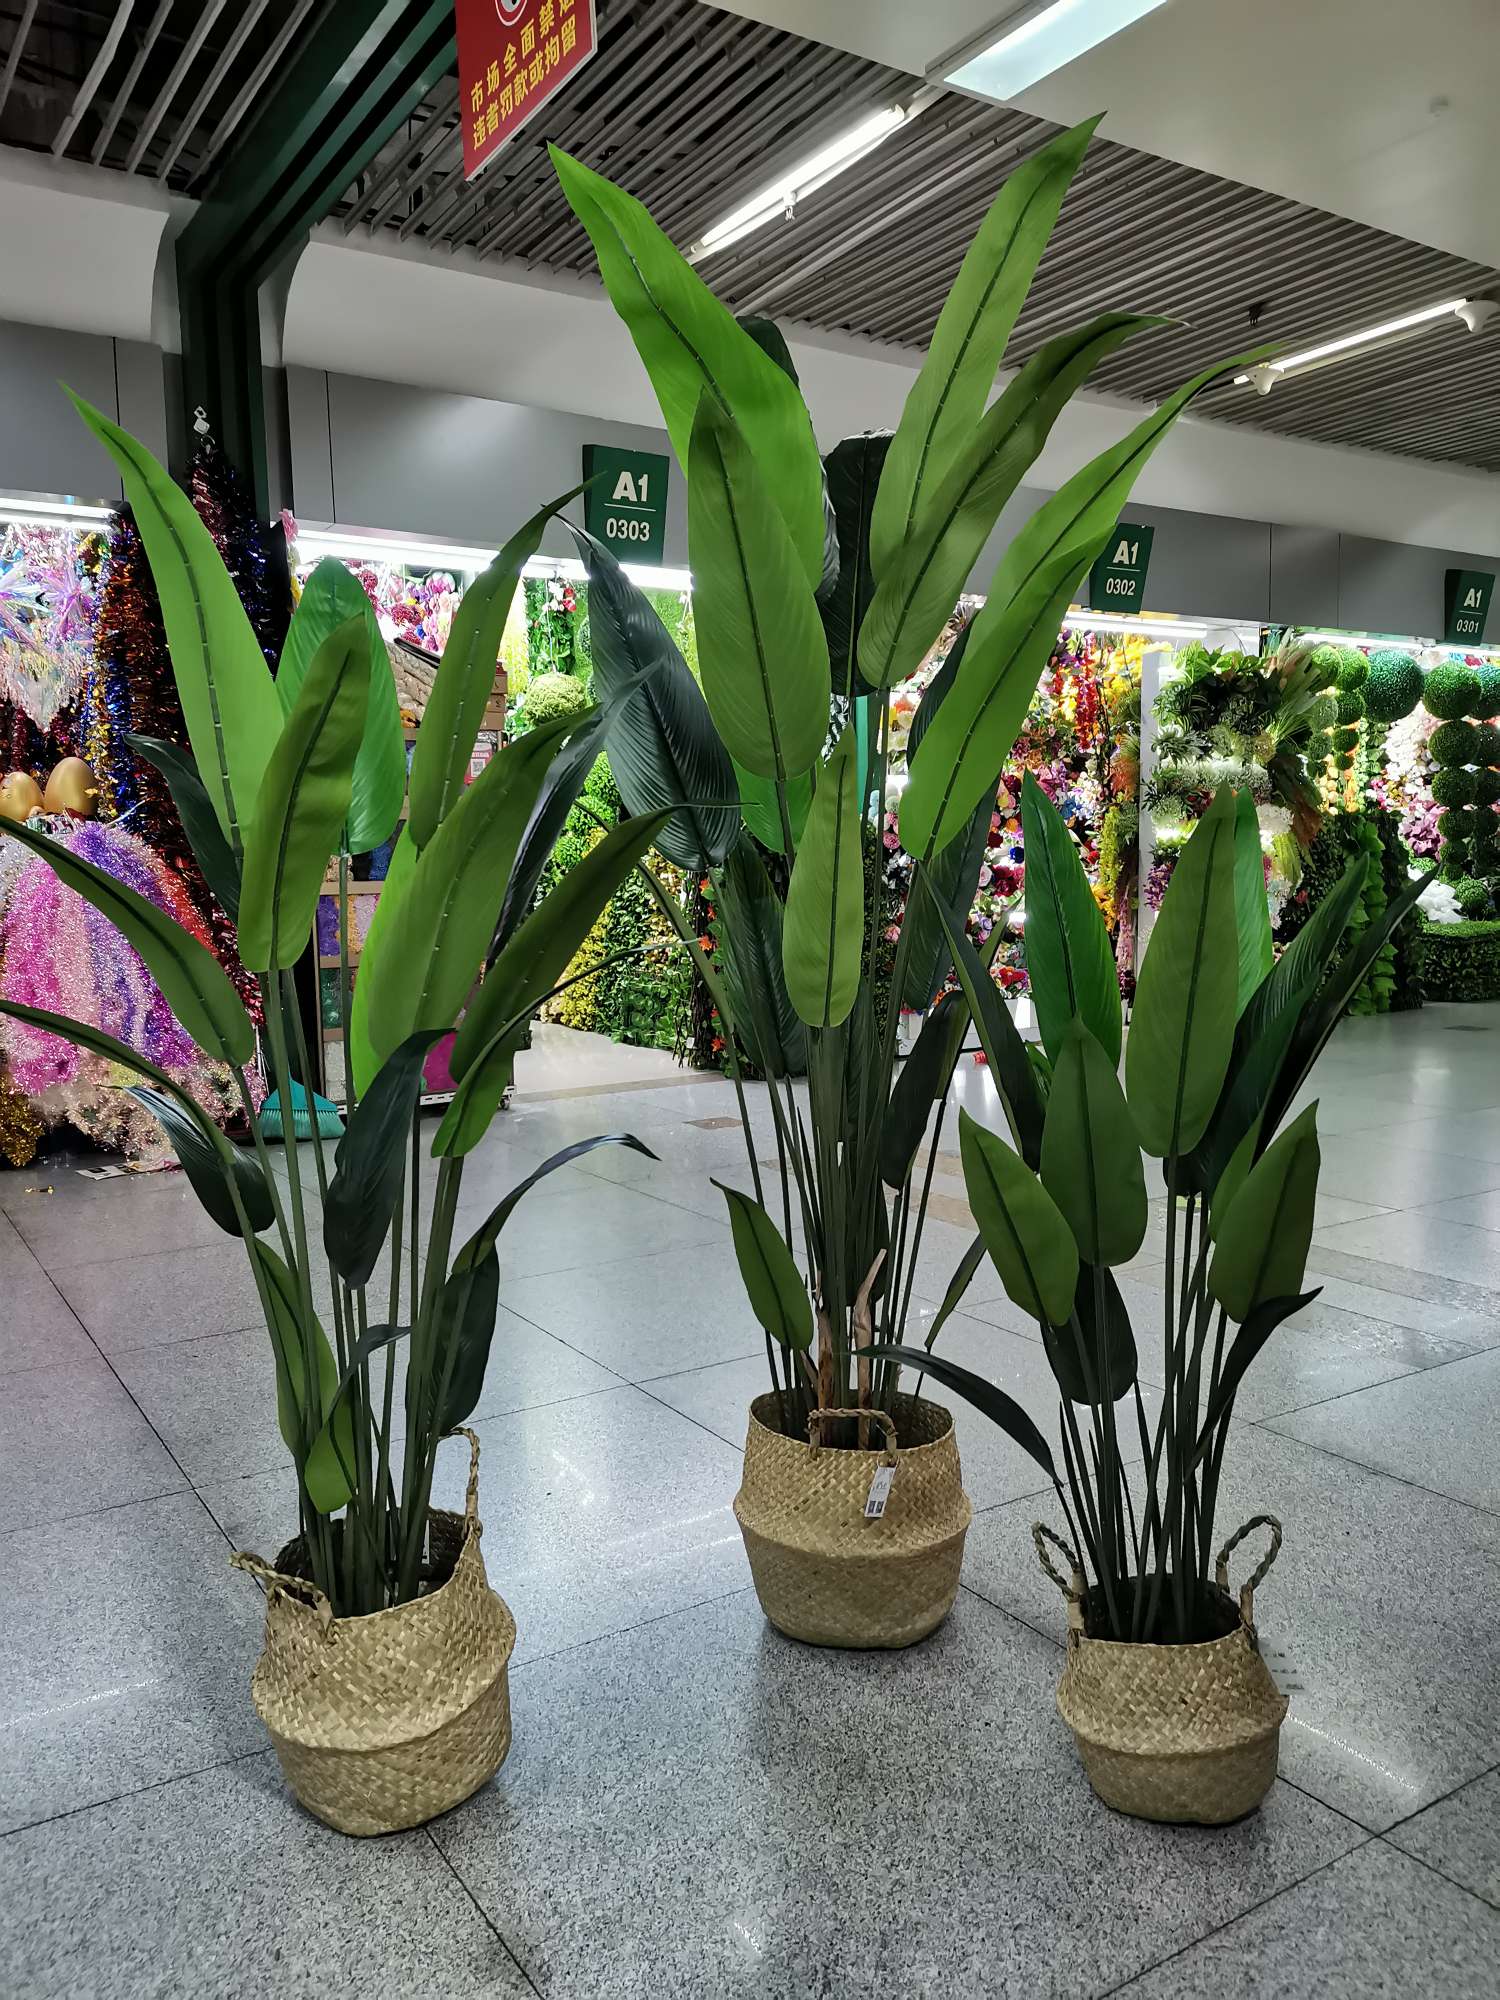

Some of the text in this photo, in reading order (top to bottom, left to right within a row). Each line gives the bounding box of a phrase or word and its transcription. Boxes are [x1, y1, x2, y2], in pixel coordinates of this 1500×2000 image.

[473, 14, 576, 151] 违者罚款或拘留
[612, 471, 649, 502] A1
[606, 517, 650, 542] 0303
[1112, 540, 1139, 565] A1
[1105, 577, 1136, 596] 0302
[1463, 588, 1483, 608] A1
[1456, 619, 1480, 633] 0301
